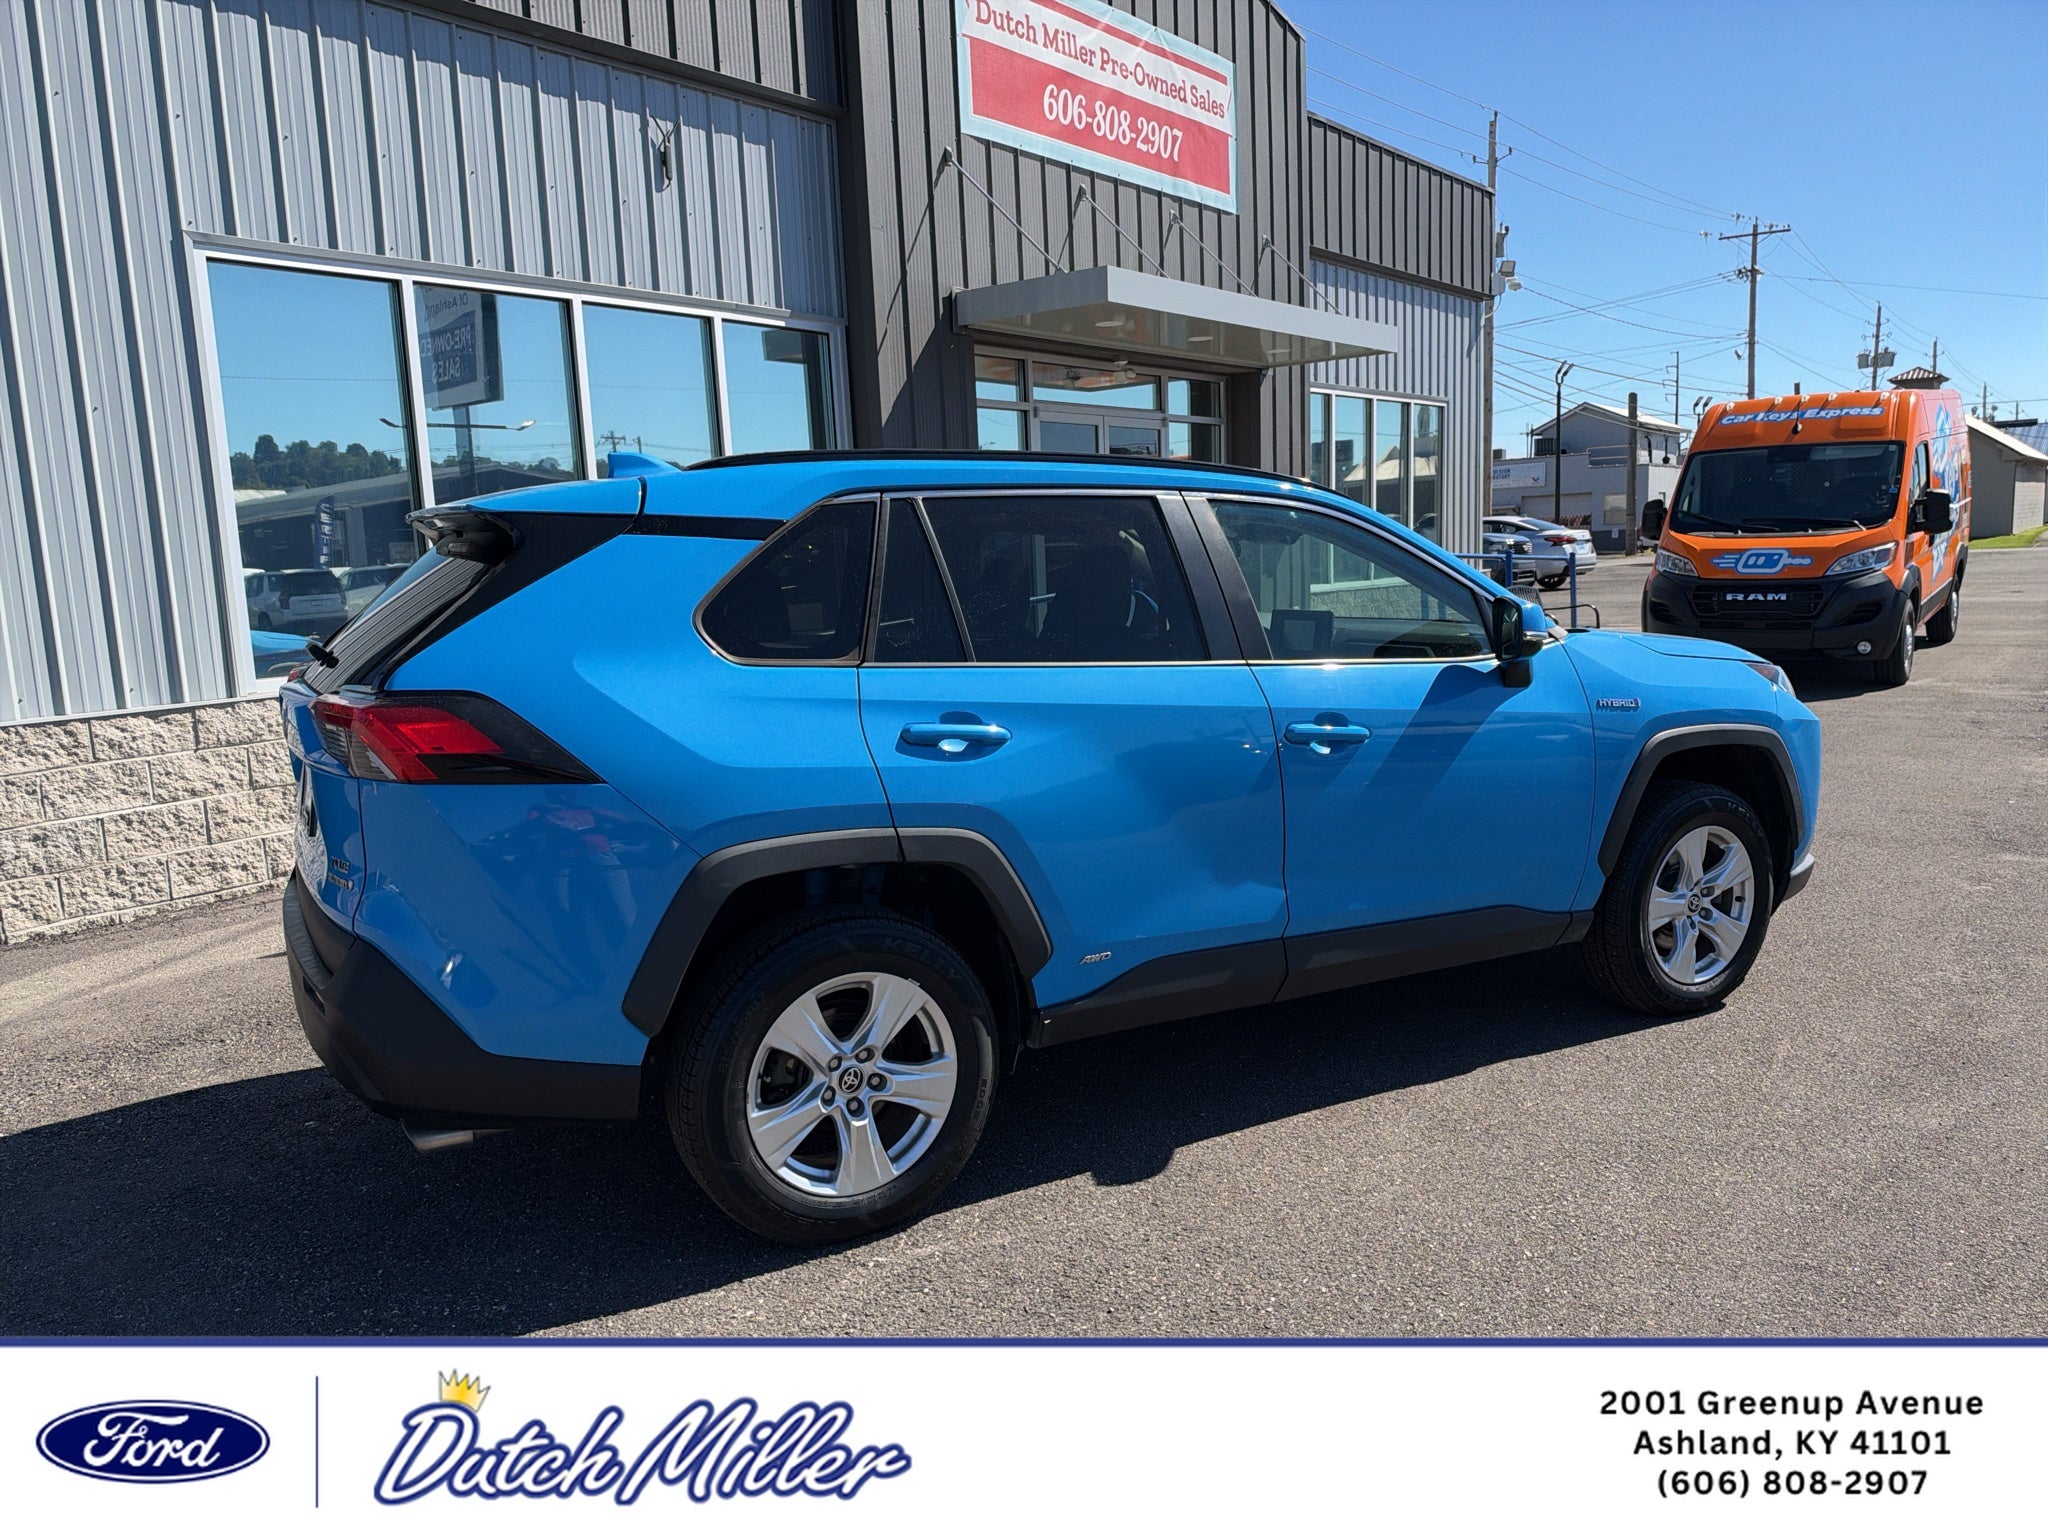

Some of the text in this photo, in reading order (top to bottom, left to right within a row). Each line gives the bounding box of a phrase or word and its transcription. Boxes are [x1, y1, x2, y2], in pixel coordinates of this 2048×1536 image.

[975, 0, 1226, 120] Dutch Miller Pre-Owned Sales
[1043, 83, 1184, 163] 606-808-2907
[1721, 414, 1754, 425] Car
[1803, 406, 1883, 419] Express
[1725, 593, 1787, 601] RAM
[1599, 698, 1637, 708] HYBRID
